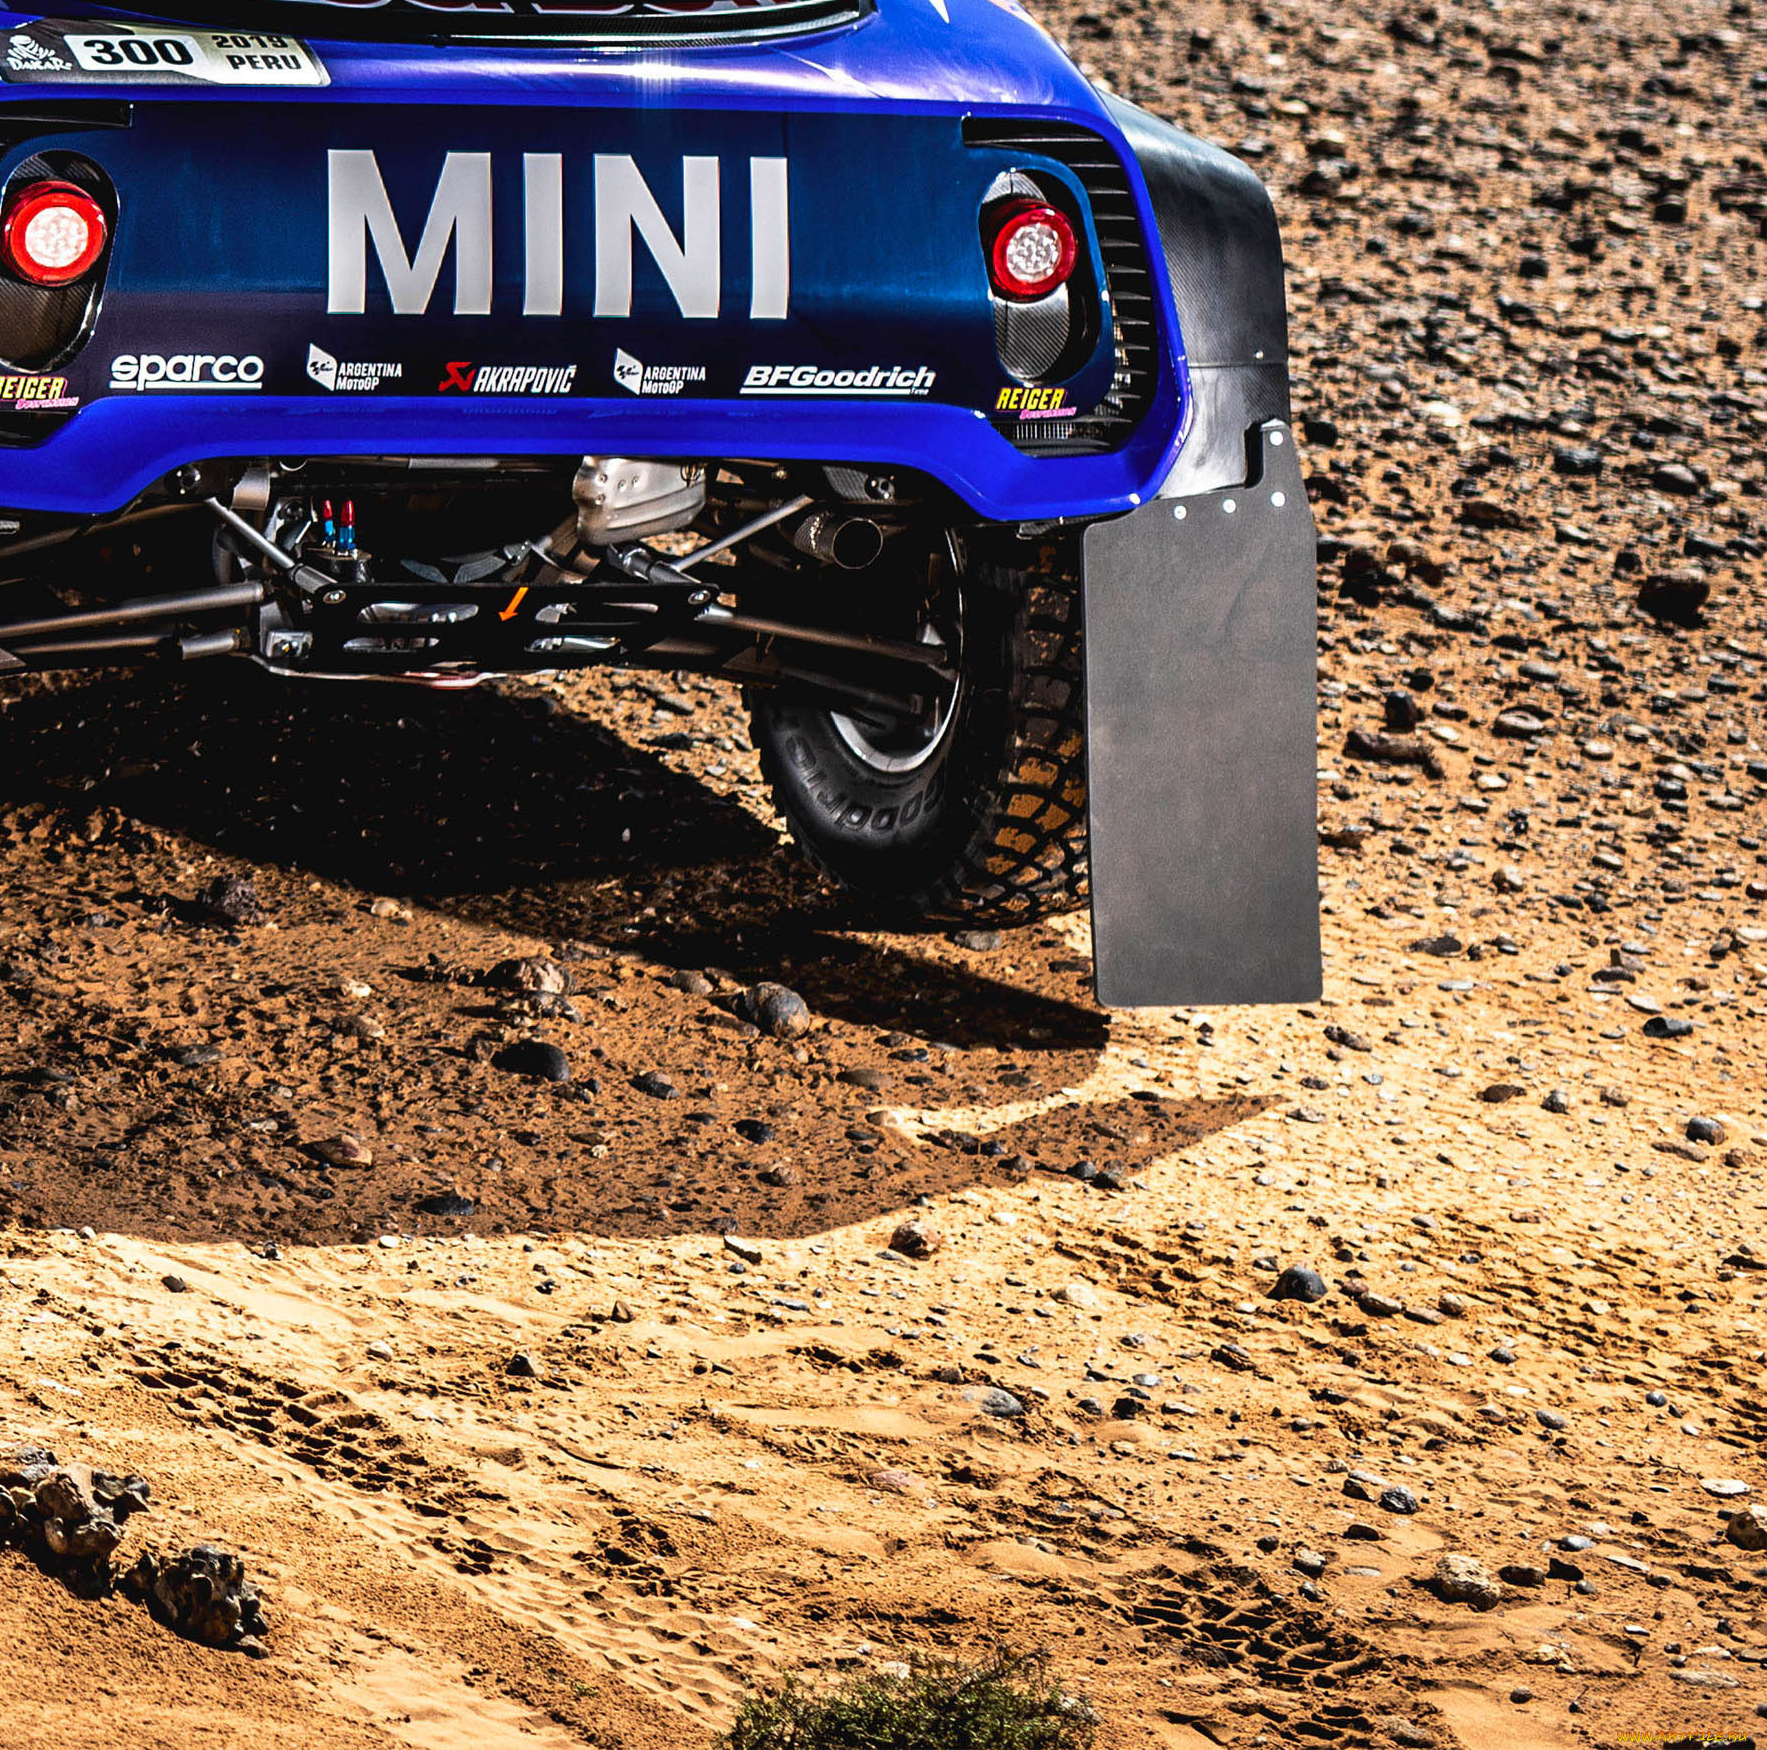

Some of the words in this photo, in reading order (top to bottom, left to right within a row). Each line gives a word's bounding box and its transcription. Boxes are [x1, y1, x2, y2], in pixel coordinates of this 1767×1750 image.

[211, 35, 289, 49] 2019
[83, 39, 194, 66] 300
[227, 54, 303, 71] PERU
[328, 149, 788, 319] MINI
[111, 354, 264, 390] sparco
[337, 362, 402, 378] ARGENTINA
[644, 366, 706, 381] ARGENTINA
[744, 365, 936, 387] BFGoodrich
[996, 388, 1065, 410] REIGER
